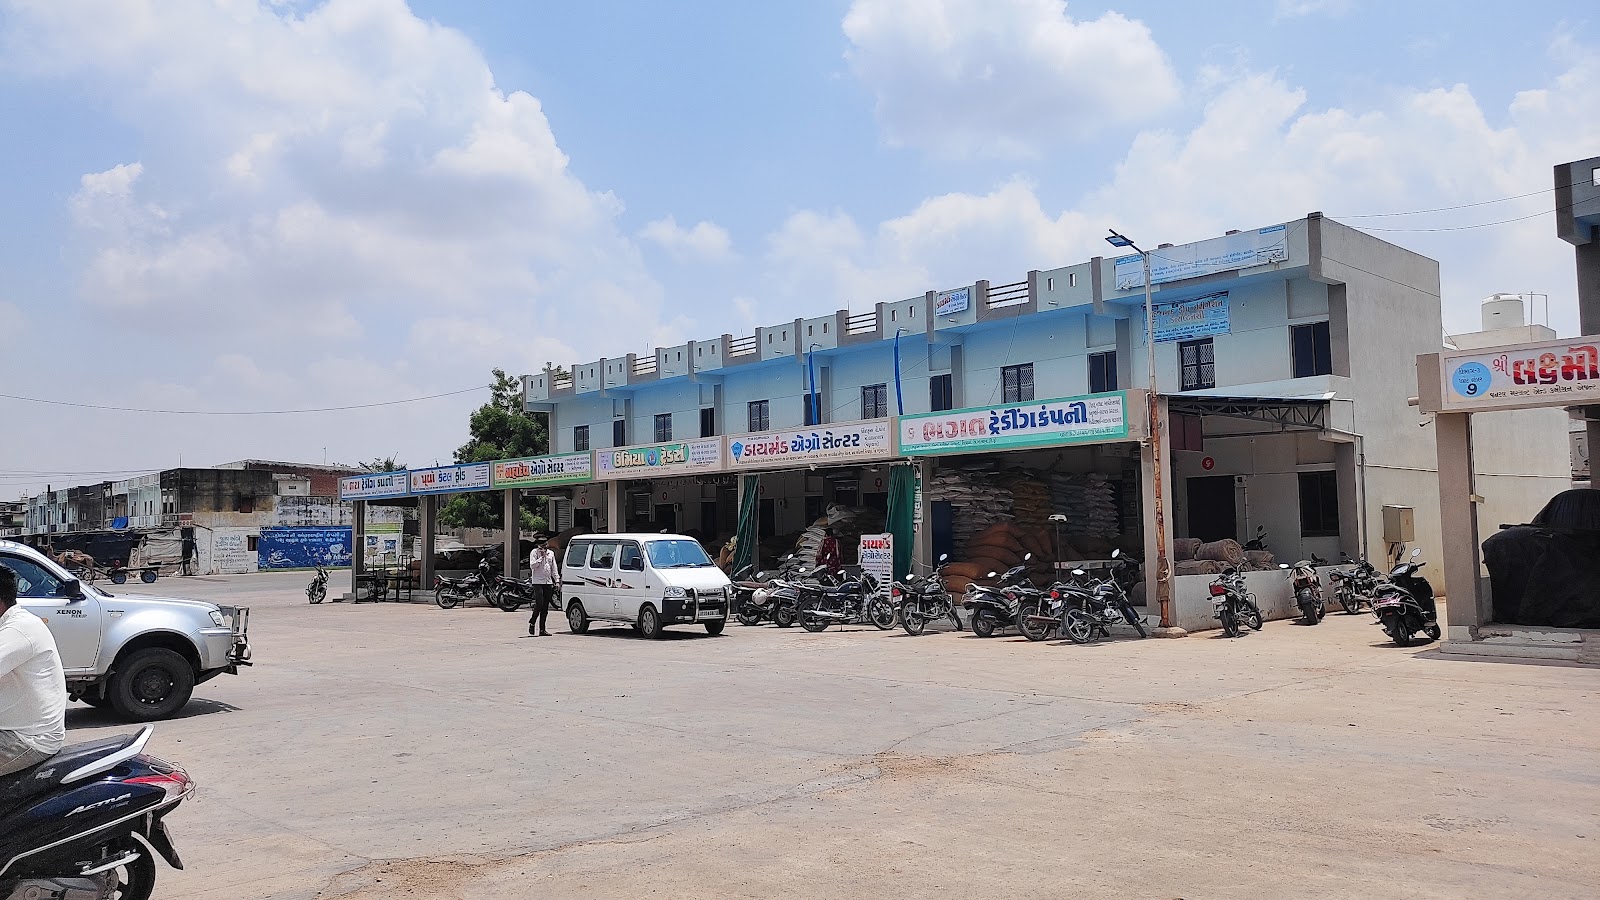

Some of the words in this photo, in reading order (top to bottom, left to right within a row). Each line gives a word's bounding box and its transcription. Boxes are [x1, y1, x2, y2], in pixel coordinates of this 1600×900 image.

[1492, 354, 1511, 377] શ્રી
[922, 417, 987, 442] ભગત
[1038, 401, 1088, 427] કંપની
[744, 436, 789, 457] ડાયમંડ
[790, 432, 821, 453] એગ્રો
[821, 431, 860, 450] સેન્ટર
[613, 450, 646, 468] ઉમિયા
